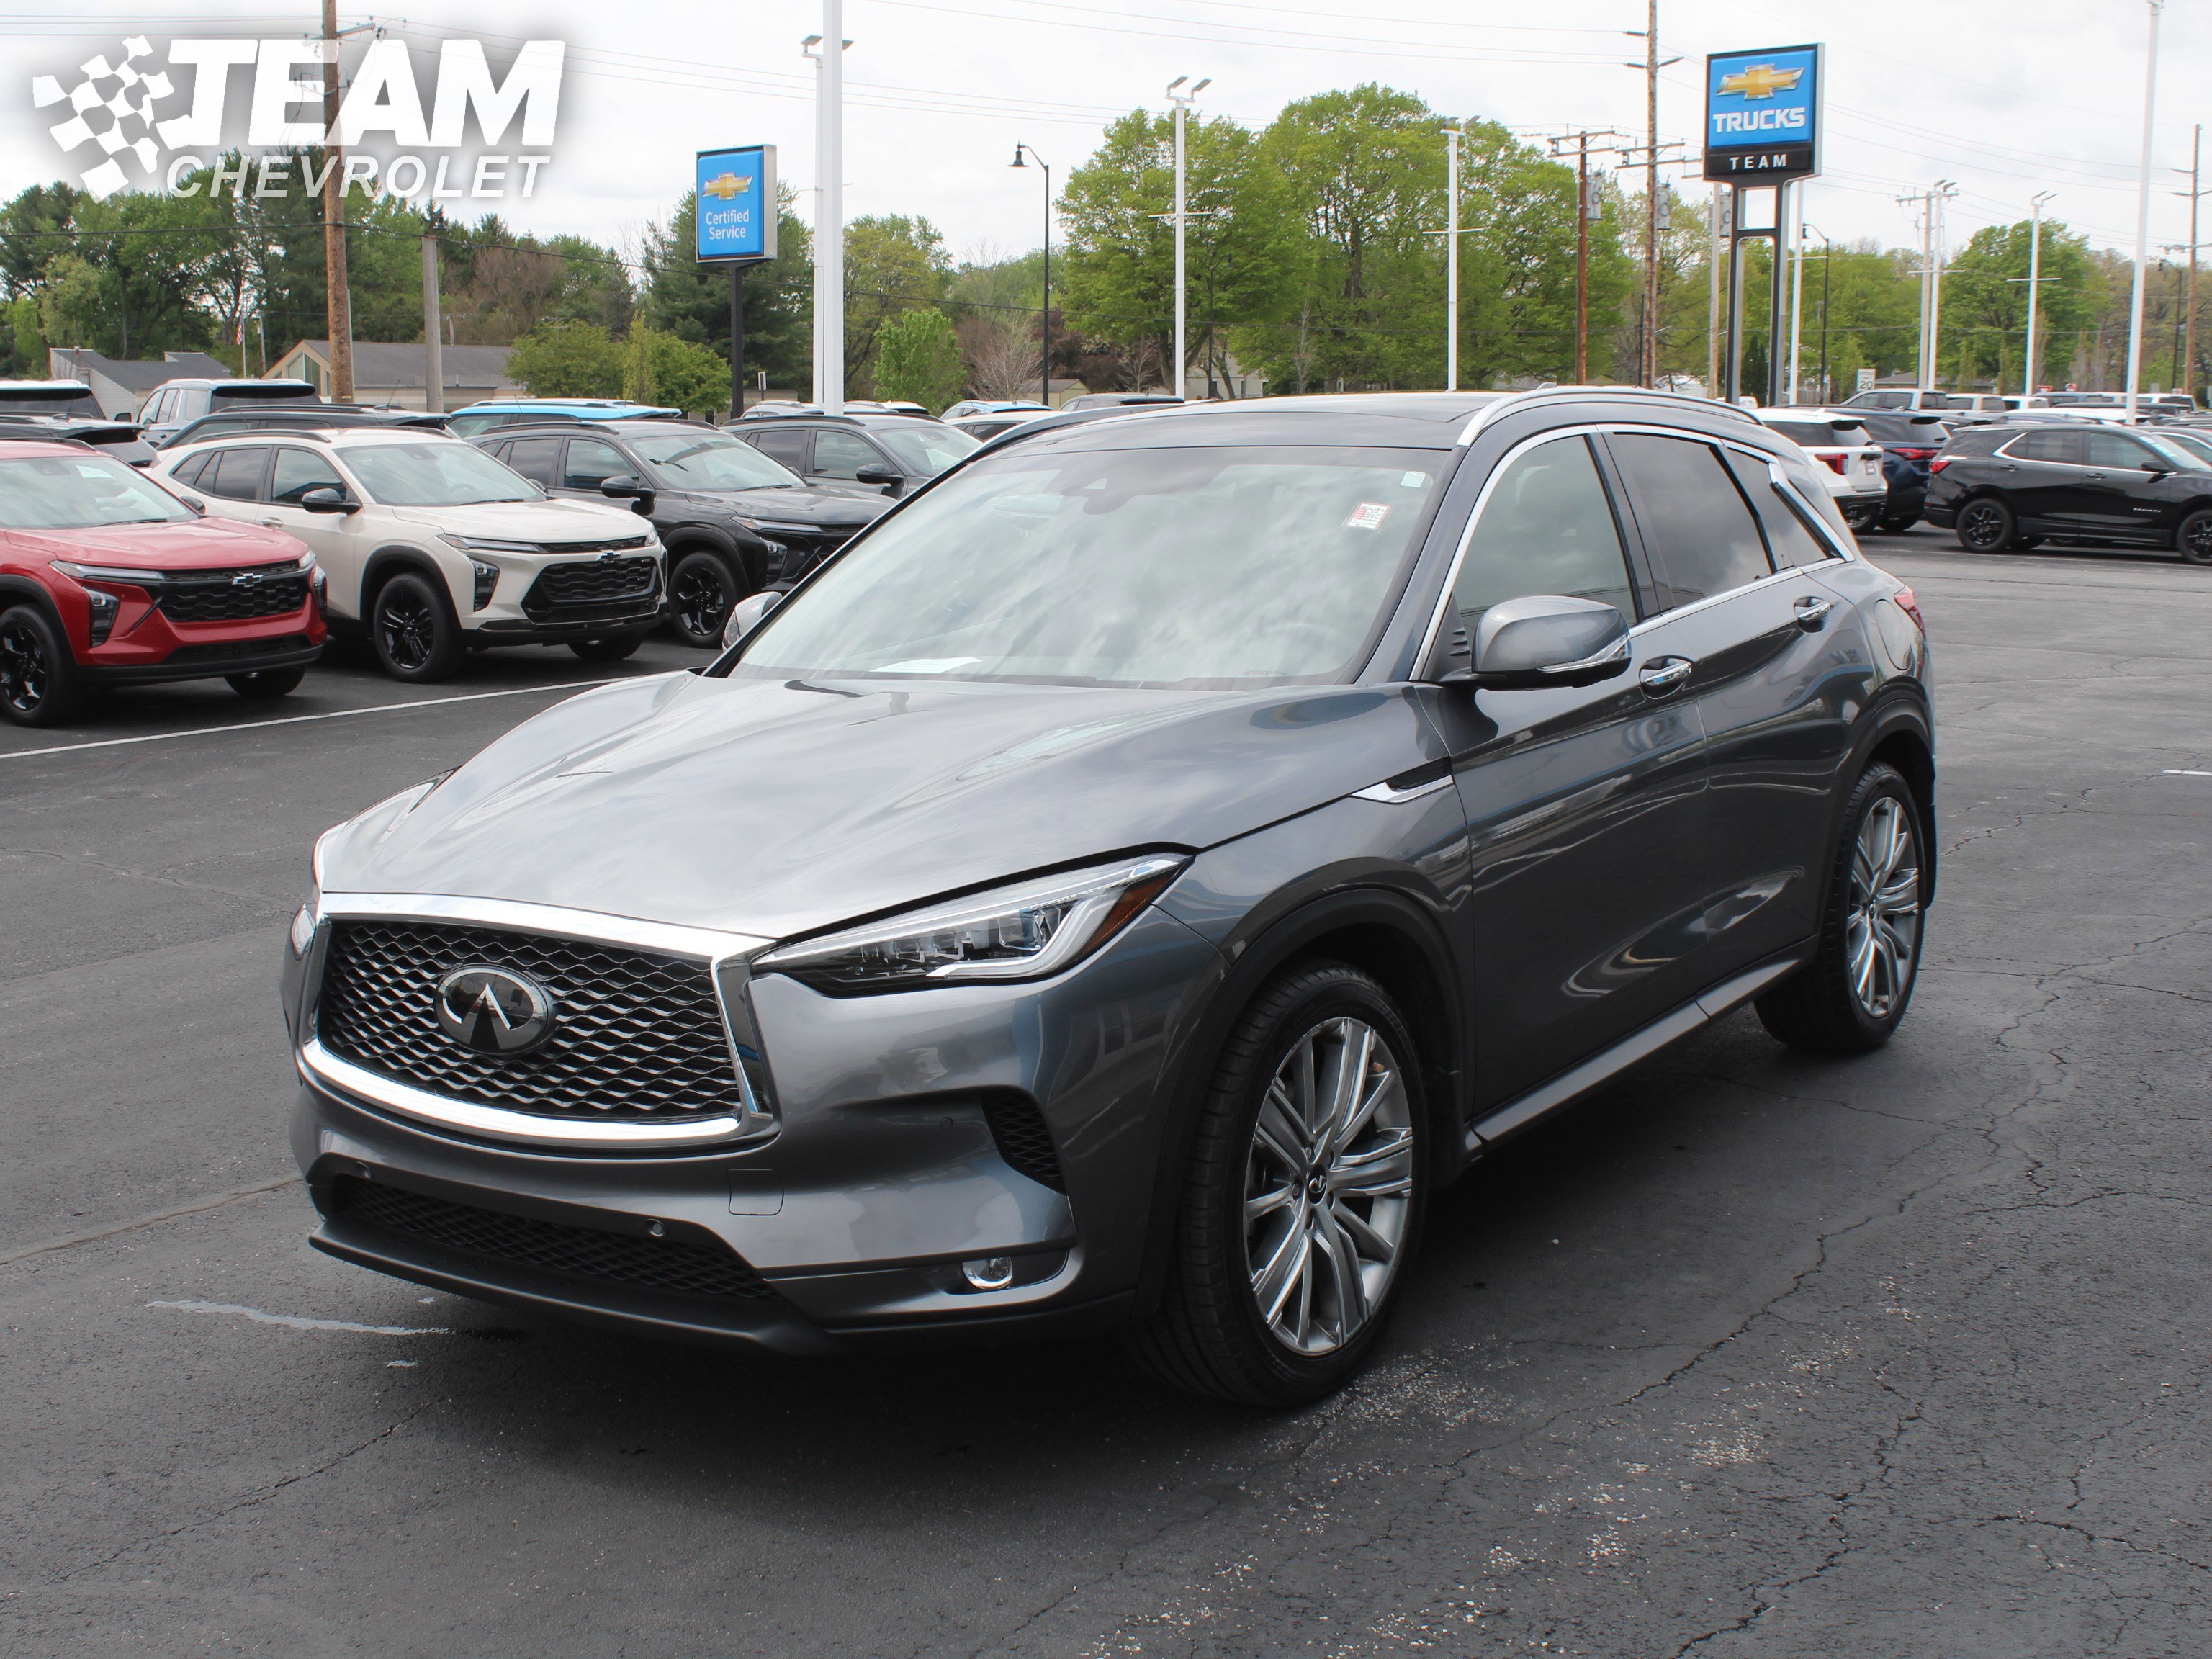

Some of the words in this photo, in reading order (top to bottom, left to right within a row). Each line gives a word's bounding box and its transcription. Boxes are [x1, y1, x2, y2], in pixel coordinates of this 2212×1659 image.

[1712, 107, 1806, 133] TRUCKS
[1729, 153, 1787, 171] TEAM
[705, 208, 750, 225] Certified
[709, 225, 747, 240] Service
[1859, 380, 1873, 390] 20
